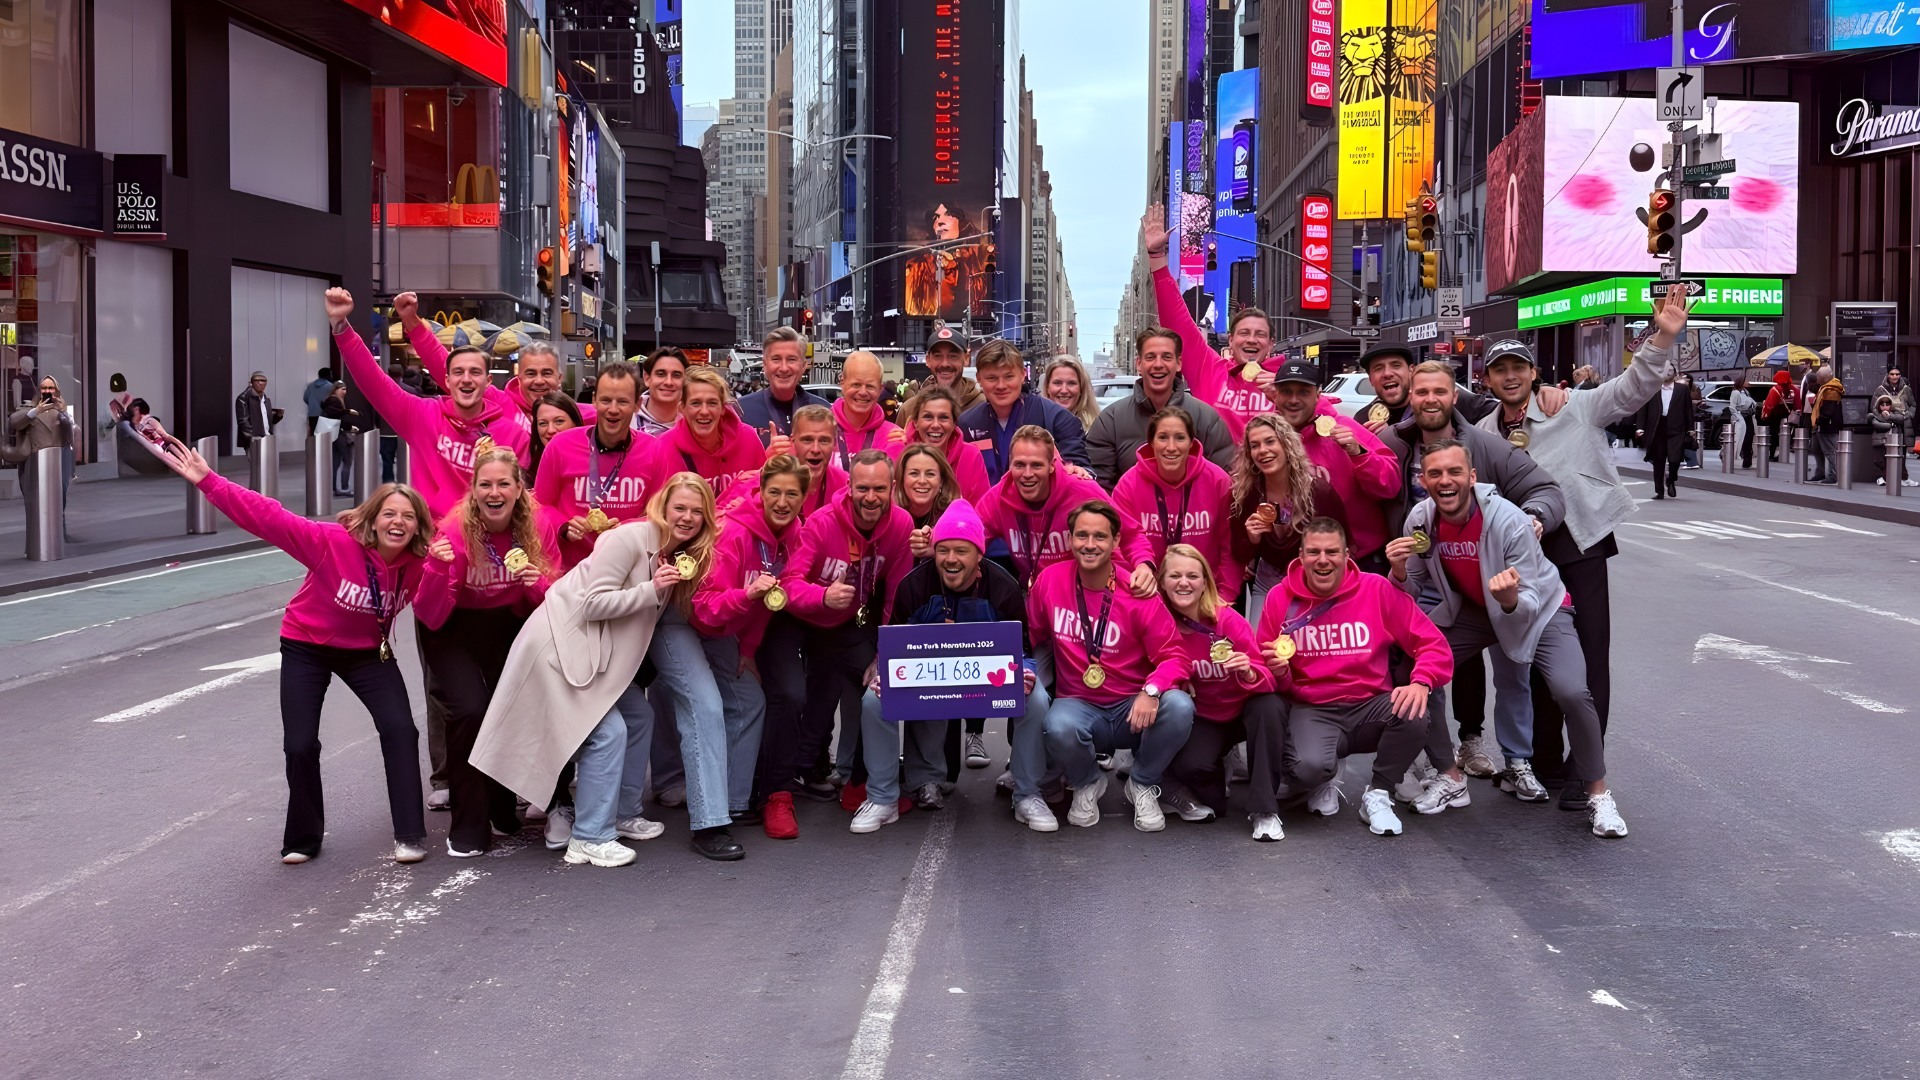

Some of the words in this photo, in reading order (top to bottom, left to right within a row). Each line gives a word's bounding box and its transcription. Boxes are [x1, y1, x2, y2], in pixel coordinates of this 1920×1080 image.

[633, 33, 646, 94] 1500
[1663, 105, 1695, 117] ONLY
[935, 90, 951, 184] FLORENCE
[117, 183, 143, 195] U.S.
[117, 196, 156, 208] POLO
[117, 209, 159, 221] ASSN.
[1440, 305, 1461, 317] 25
[914, 662, 947, 681] 241
[953, 660, 981, 680] 688
